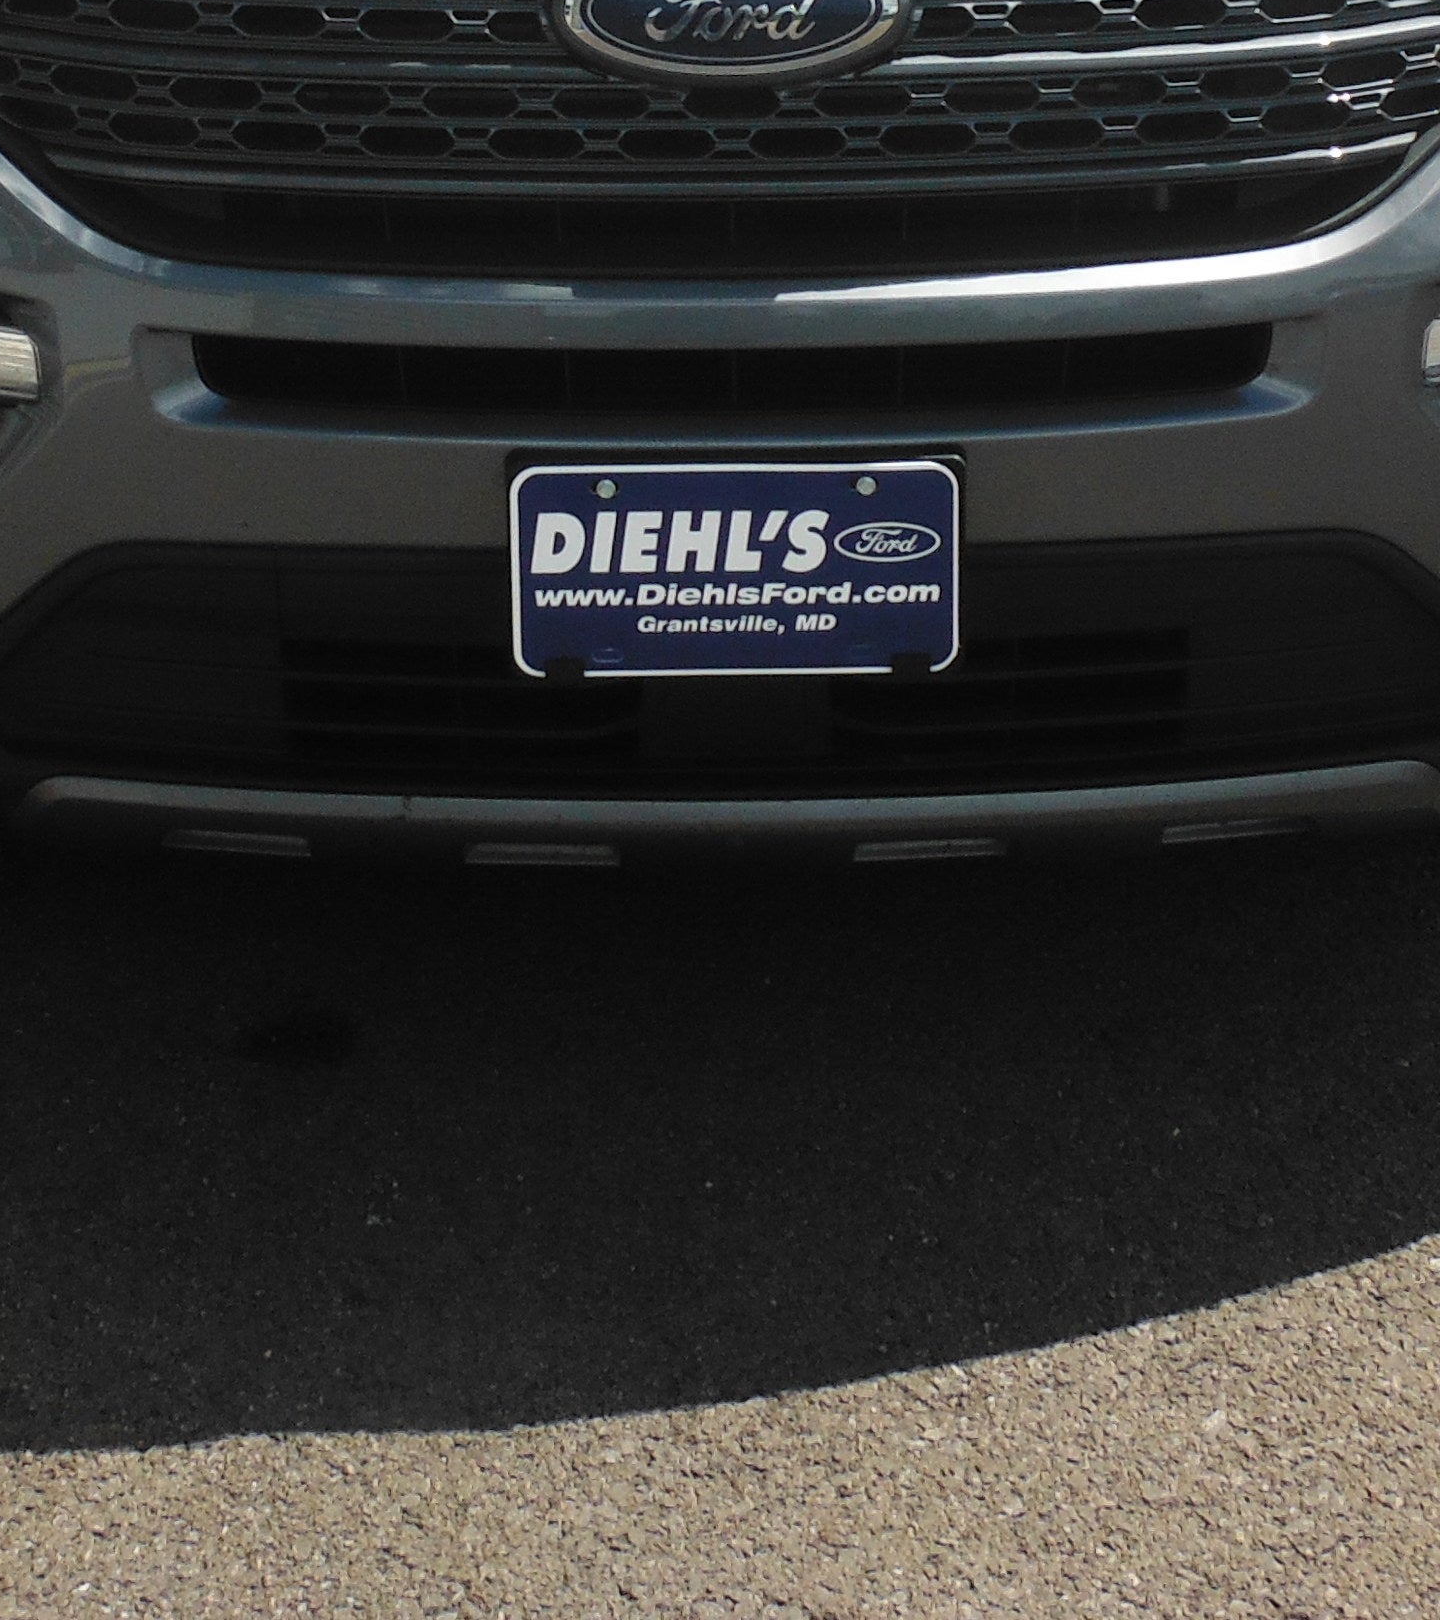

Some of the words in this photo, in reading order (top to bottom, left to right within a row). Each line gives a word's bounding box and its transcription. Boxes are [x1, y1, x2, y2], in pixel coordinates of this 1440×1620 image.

[530, 509, 830, 574] DIEHL'S
[855, 528, 919, 554] Ford
[534, 582, 941, 608] www.DiehlsFord.com
[637, 615, 786, 634] Grantsville,
[795, 614, 838, 632] MD
